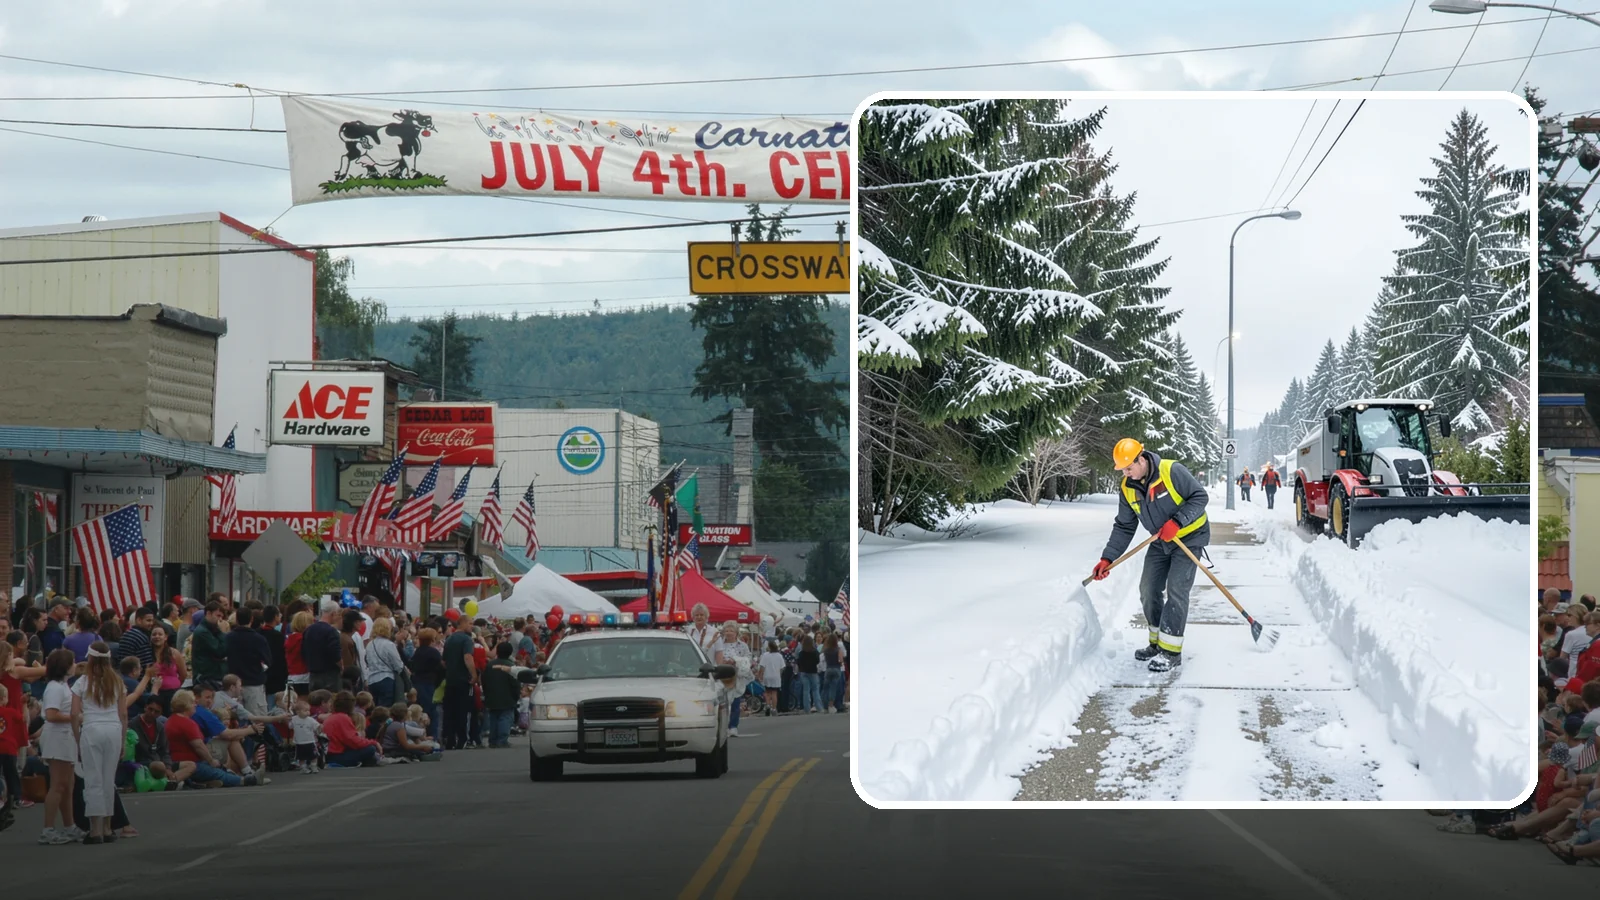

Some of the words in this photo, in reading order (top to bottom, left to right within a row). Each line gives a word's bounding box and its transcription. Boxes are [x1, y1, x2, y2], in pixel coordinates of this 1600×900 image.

[481, 141, 604, 193] JULY
[633, 150, 747, 198] 4th.
[697, 254, 850, 280] CROSSWA
[283, 380, 373, 419] ACE
[406, 409, 452, 421] CEDAR
[284, 421, 370, 436] Hardware
[96, 485, 124, 494] Vincent
[126, 485, 136, 494] de
[137, 485, 155, 495] Paul
[688, 526, 741, 535] CRNATION
